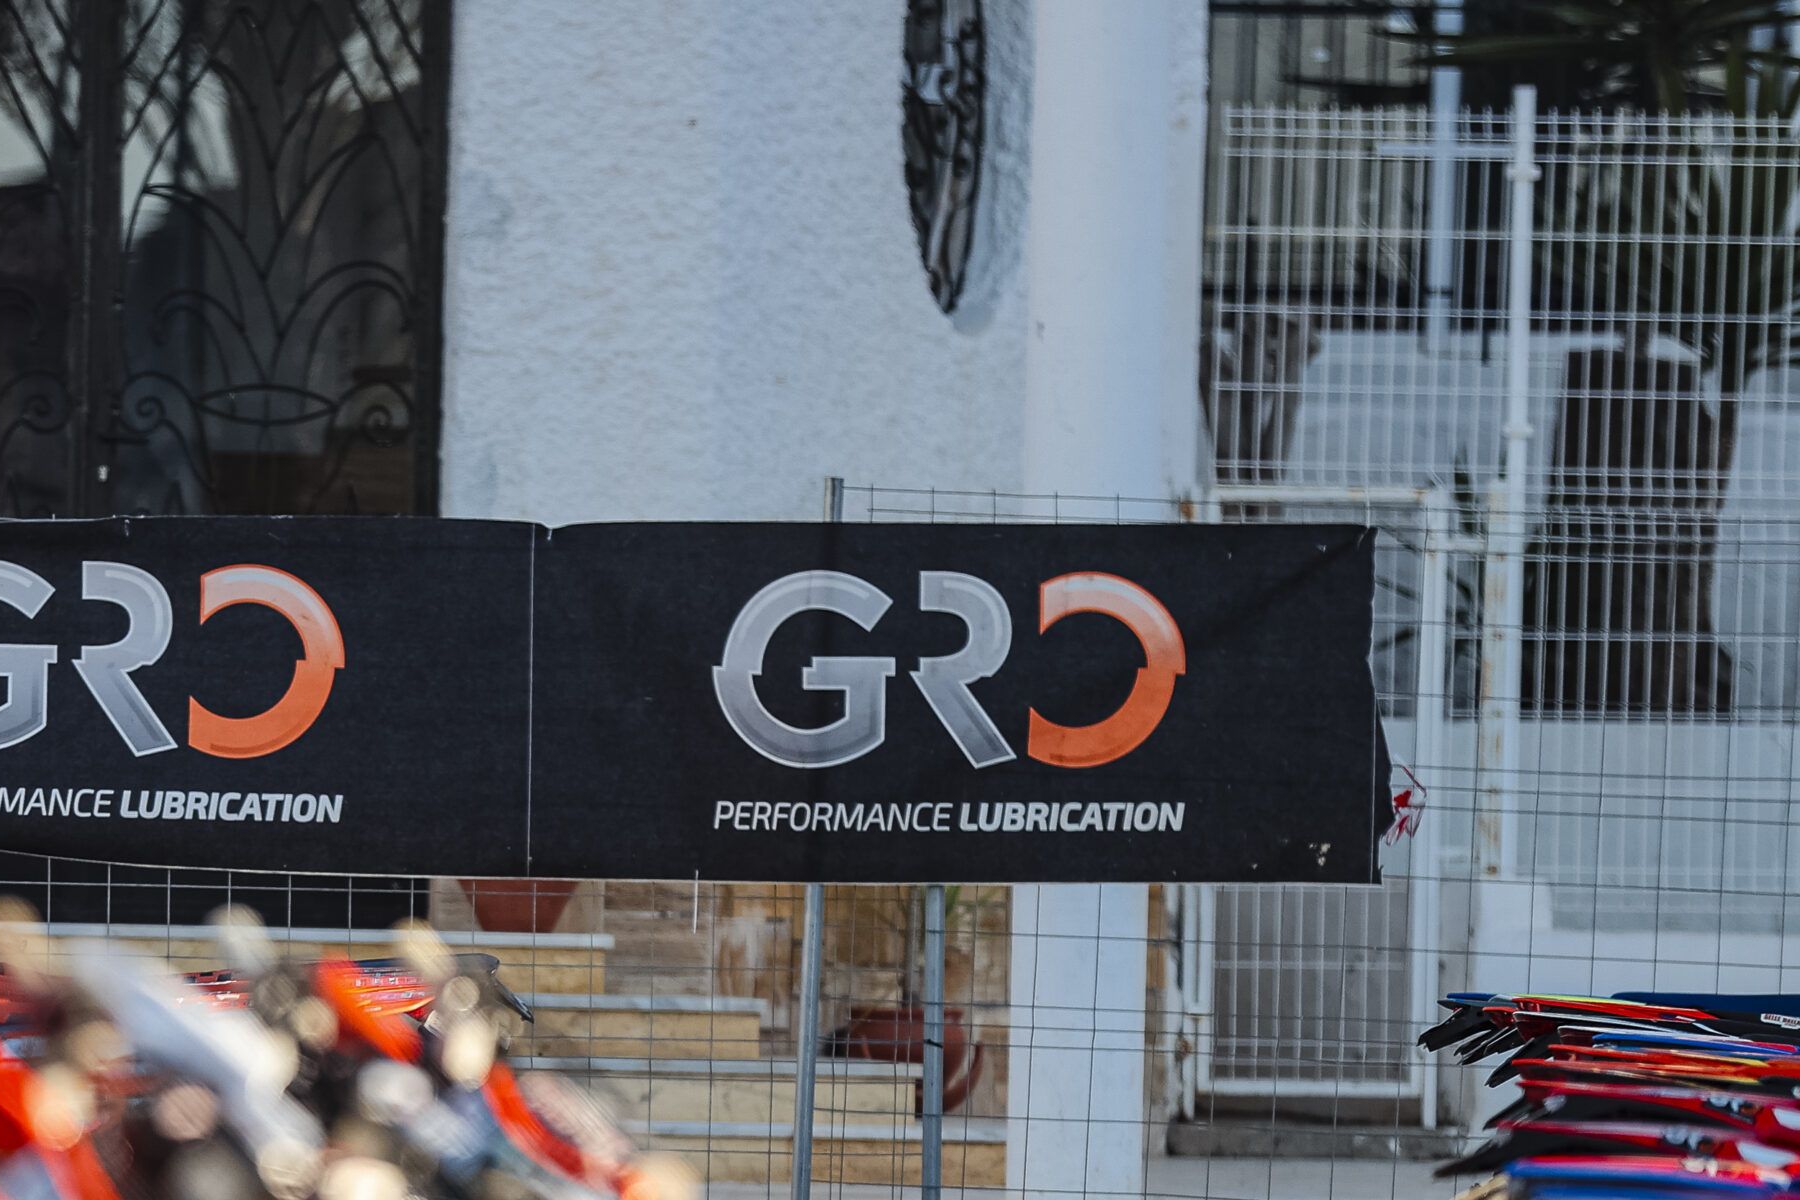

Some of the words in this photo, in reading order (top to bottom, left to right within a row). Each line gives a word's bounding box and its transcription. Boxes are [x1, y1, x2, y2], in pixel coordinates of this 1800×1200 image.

[712, 570, 1187, 769] GRO
[119, 789, 344, 824] LUBRICATION
[713, 800, 954, 832] PERFORMANCE
[959, 801, 1186, 832] LUBRICATION
